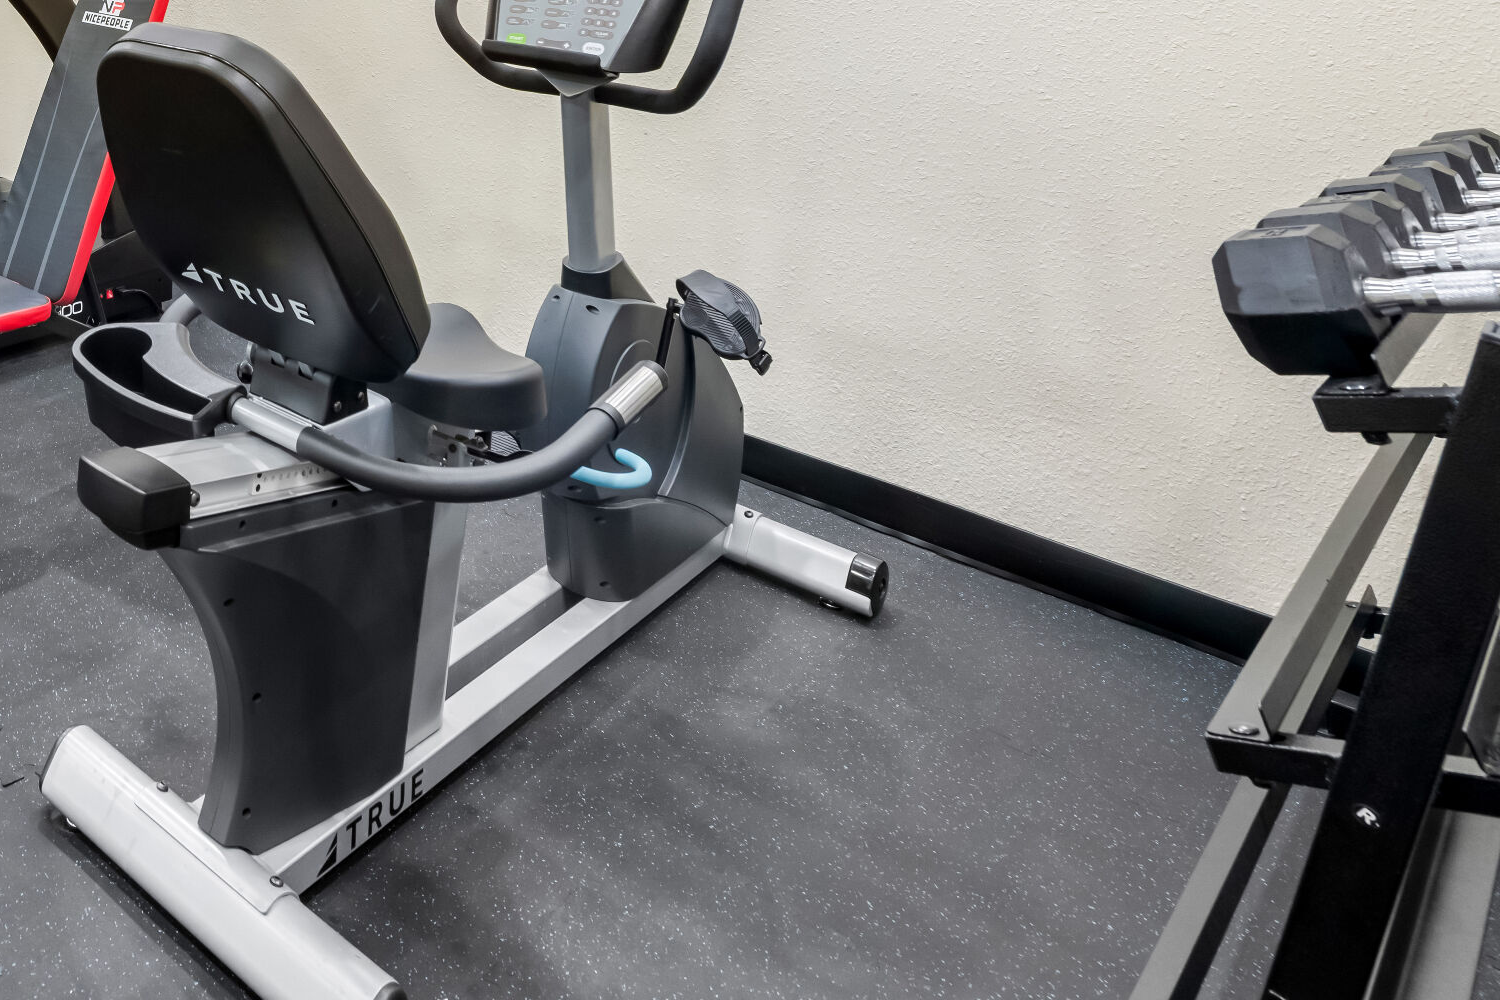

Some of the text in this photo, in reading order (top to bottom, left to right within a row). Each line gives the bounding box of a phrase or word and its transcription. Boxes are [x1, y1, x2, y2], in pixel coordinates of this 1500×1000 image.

[84, 12, 130, 29] NICEPEOPLE
[202, 267, 316, 326] TRUE
[346, 768, 424, 850] TRUE
